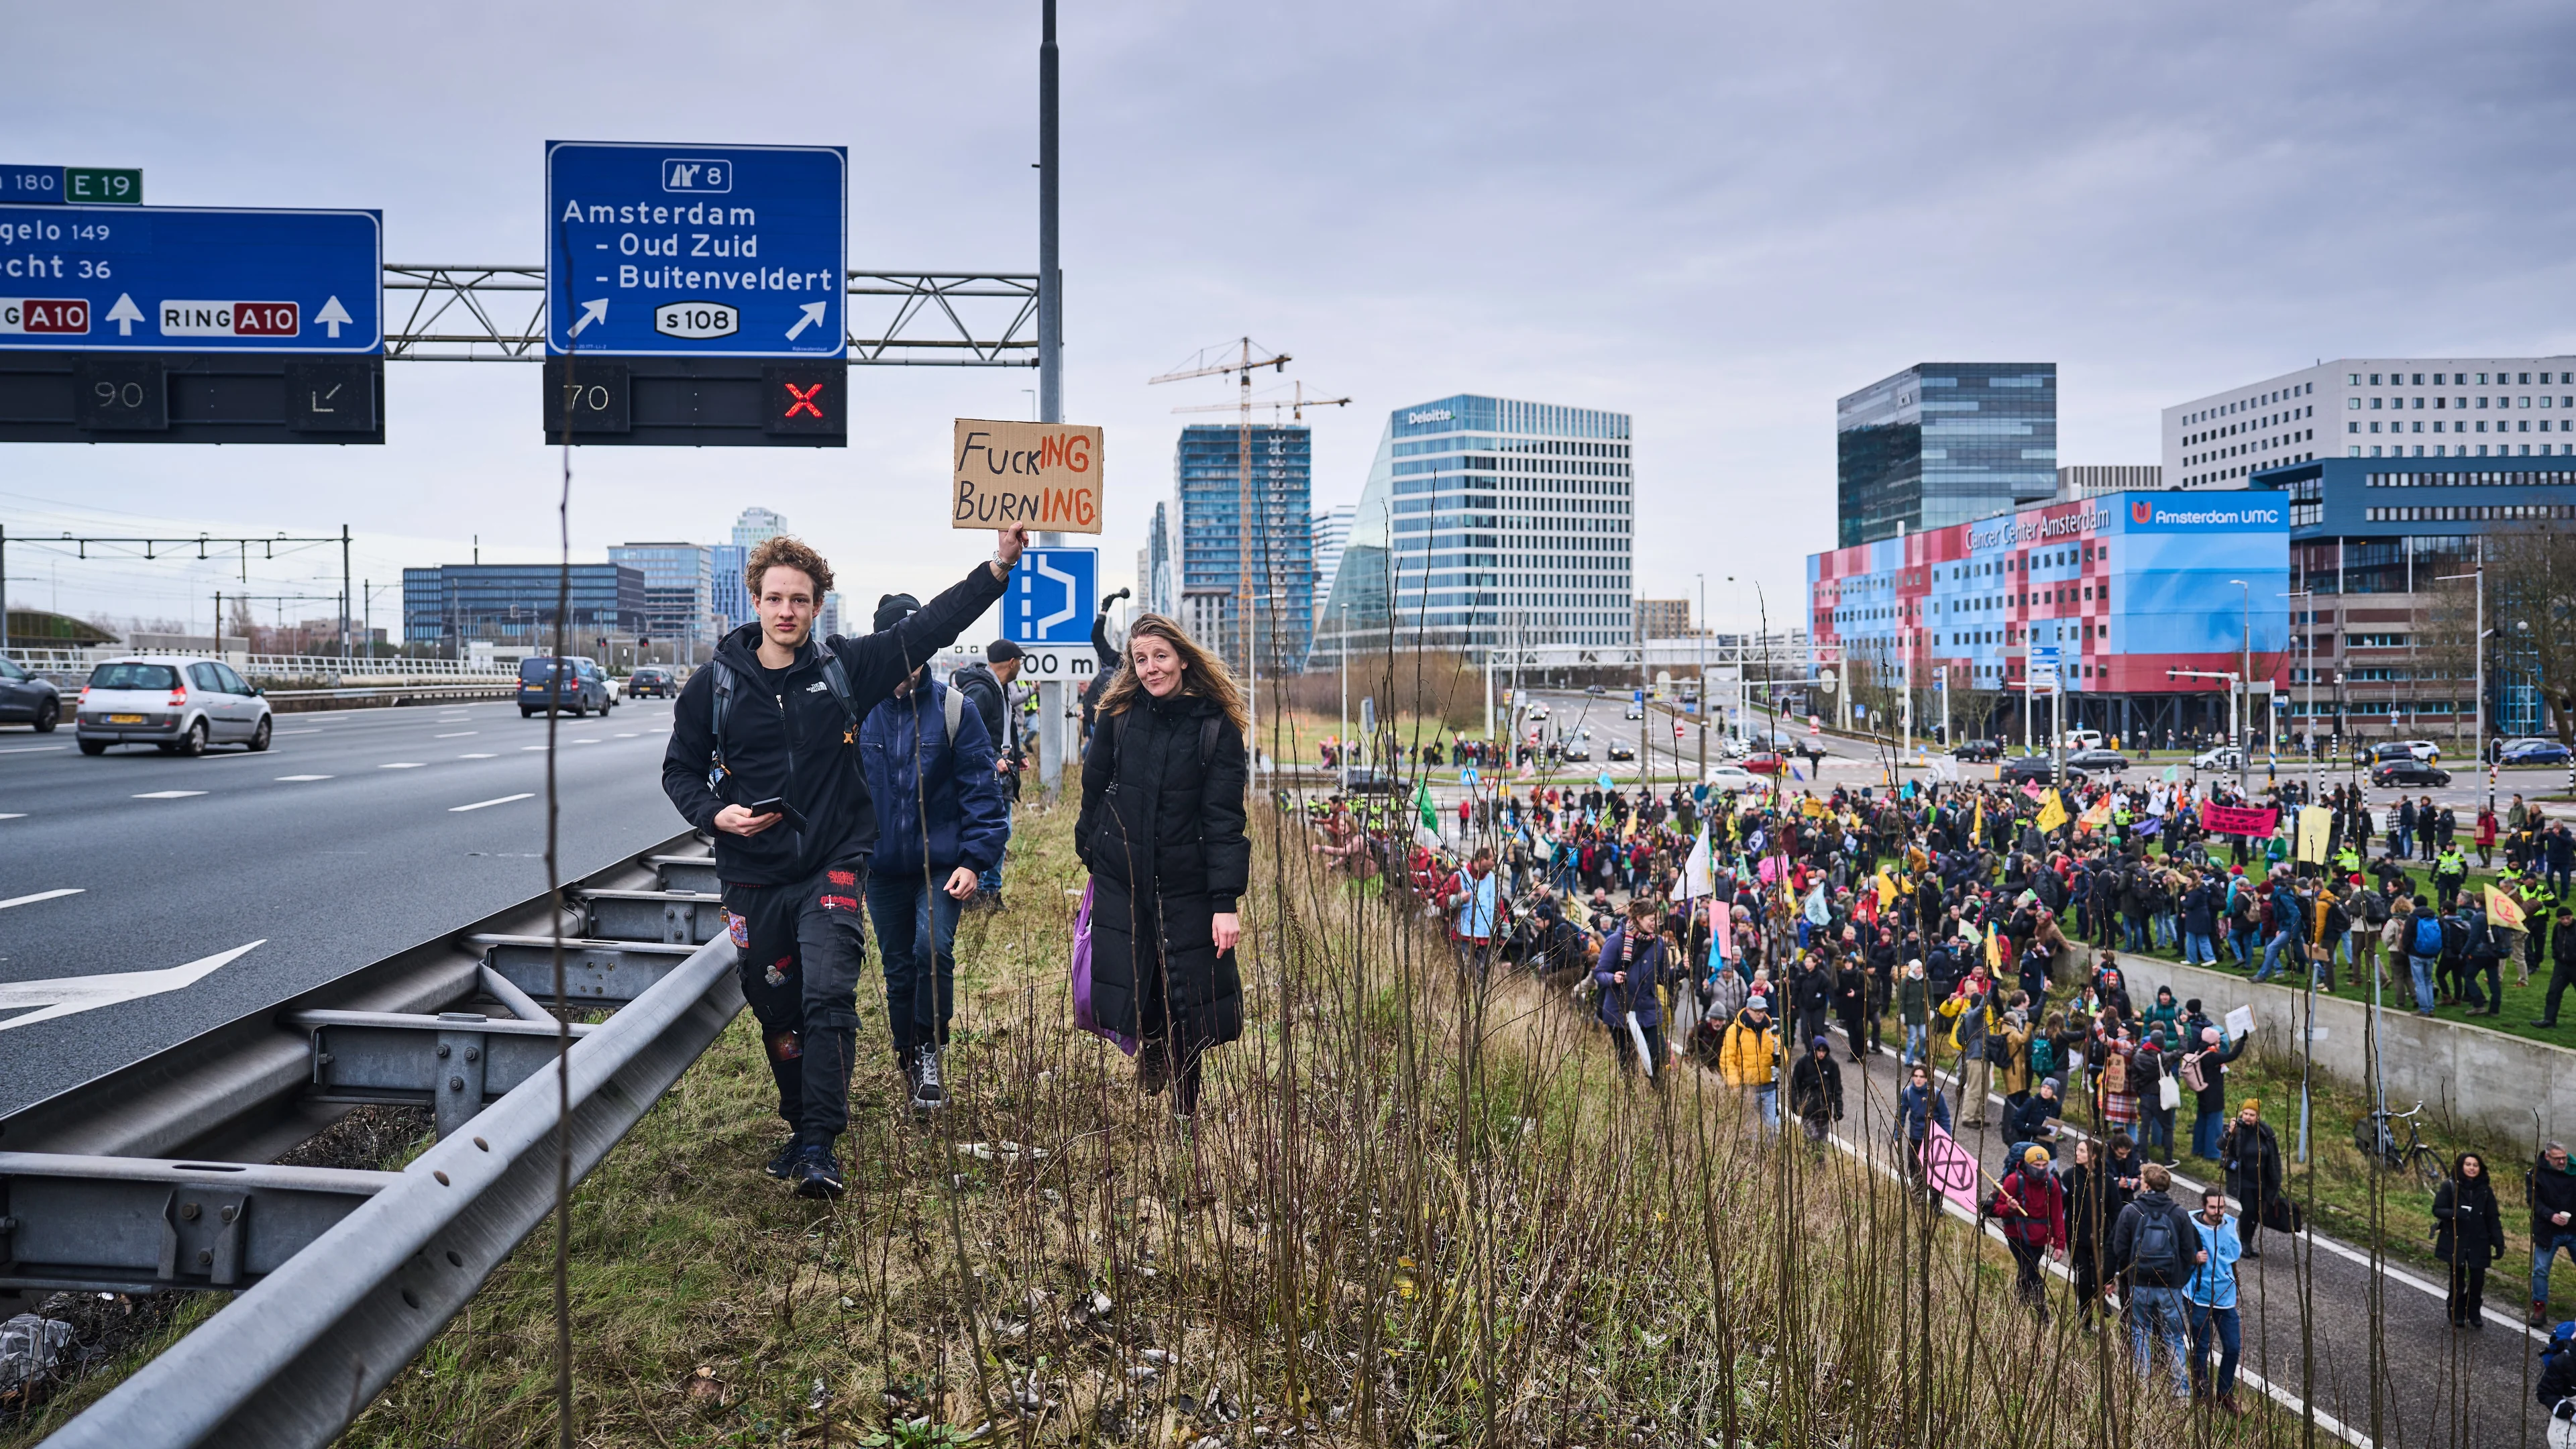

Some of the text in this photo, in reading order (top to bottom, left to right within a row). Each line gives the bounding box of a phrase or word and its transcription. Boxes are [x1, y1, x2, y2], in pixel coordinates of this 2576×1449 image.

[15, 174, 54, 191] 180
[707, 168, 722, 185] 8
[562, 200, 755, 226] Amsterdam
[71, 224, 110, 241] 149
[619, 233, 678, 258] Oud
[691, 234, 757, 258] Zuid
[0, 254, 111, 279] cht 36
[619, 265, 833, 291] Buitenveldert
[30, 306, 84, 327] A10
[165, 309, 294, 329] RING A10
[95, 380, 144, 408] 90
[563, 384, 609, 411] 70
[958, 432, 1091, 476] FUCKING
[956, 480, 1096, 526] BURNING
[1966, 506, 2110, 550] Cancer Center Amsterdam
[2155, 509, 2279, 525] Amsterdam UMC
[1022, 653, 1093, 674] 00 m
